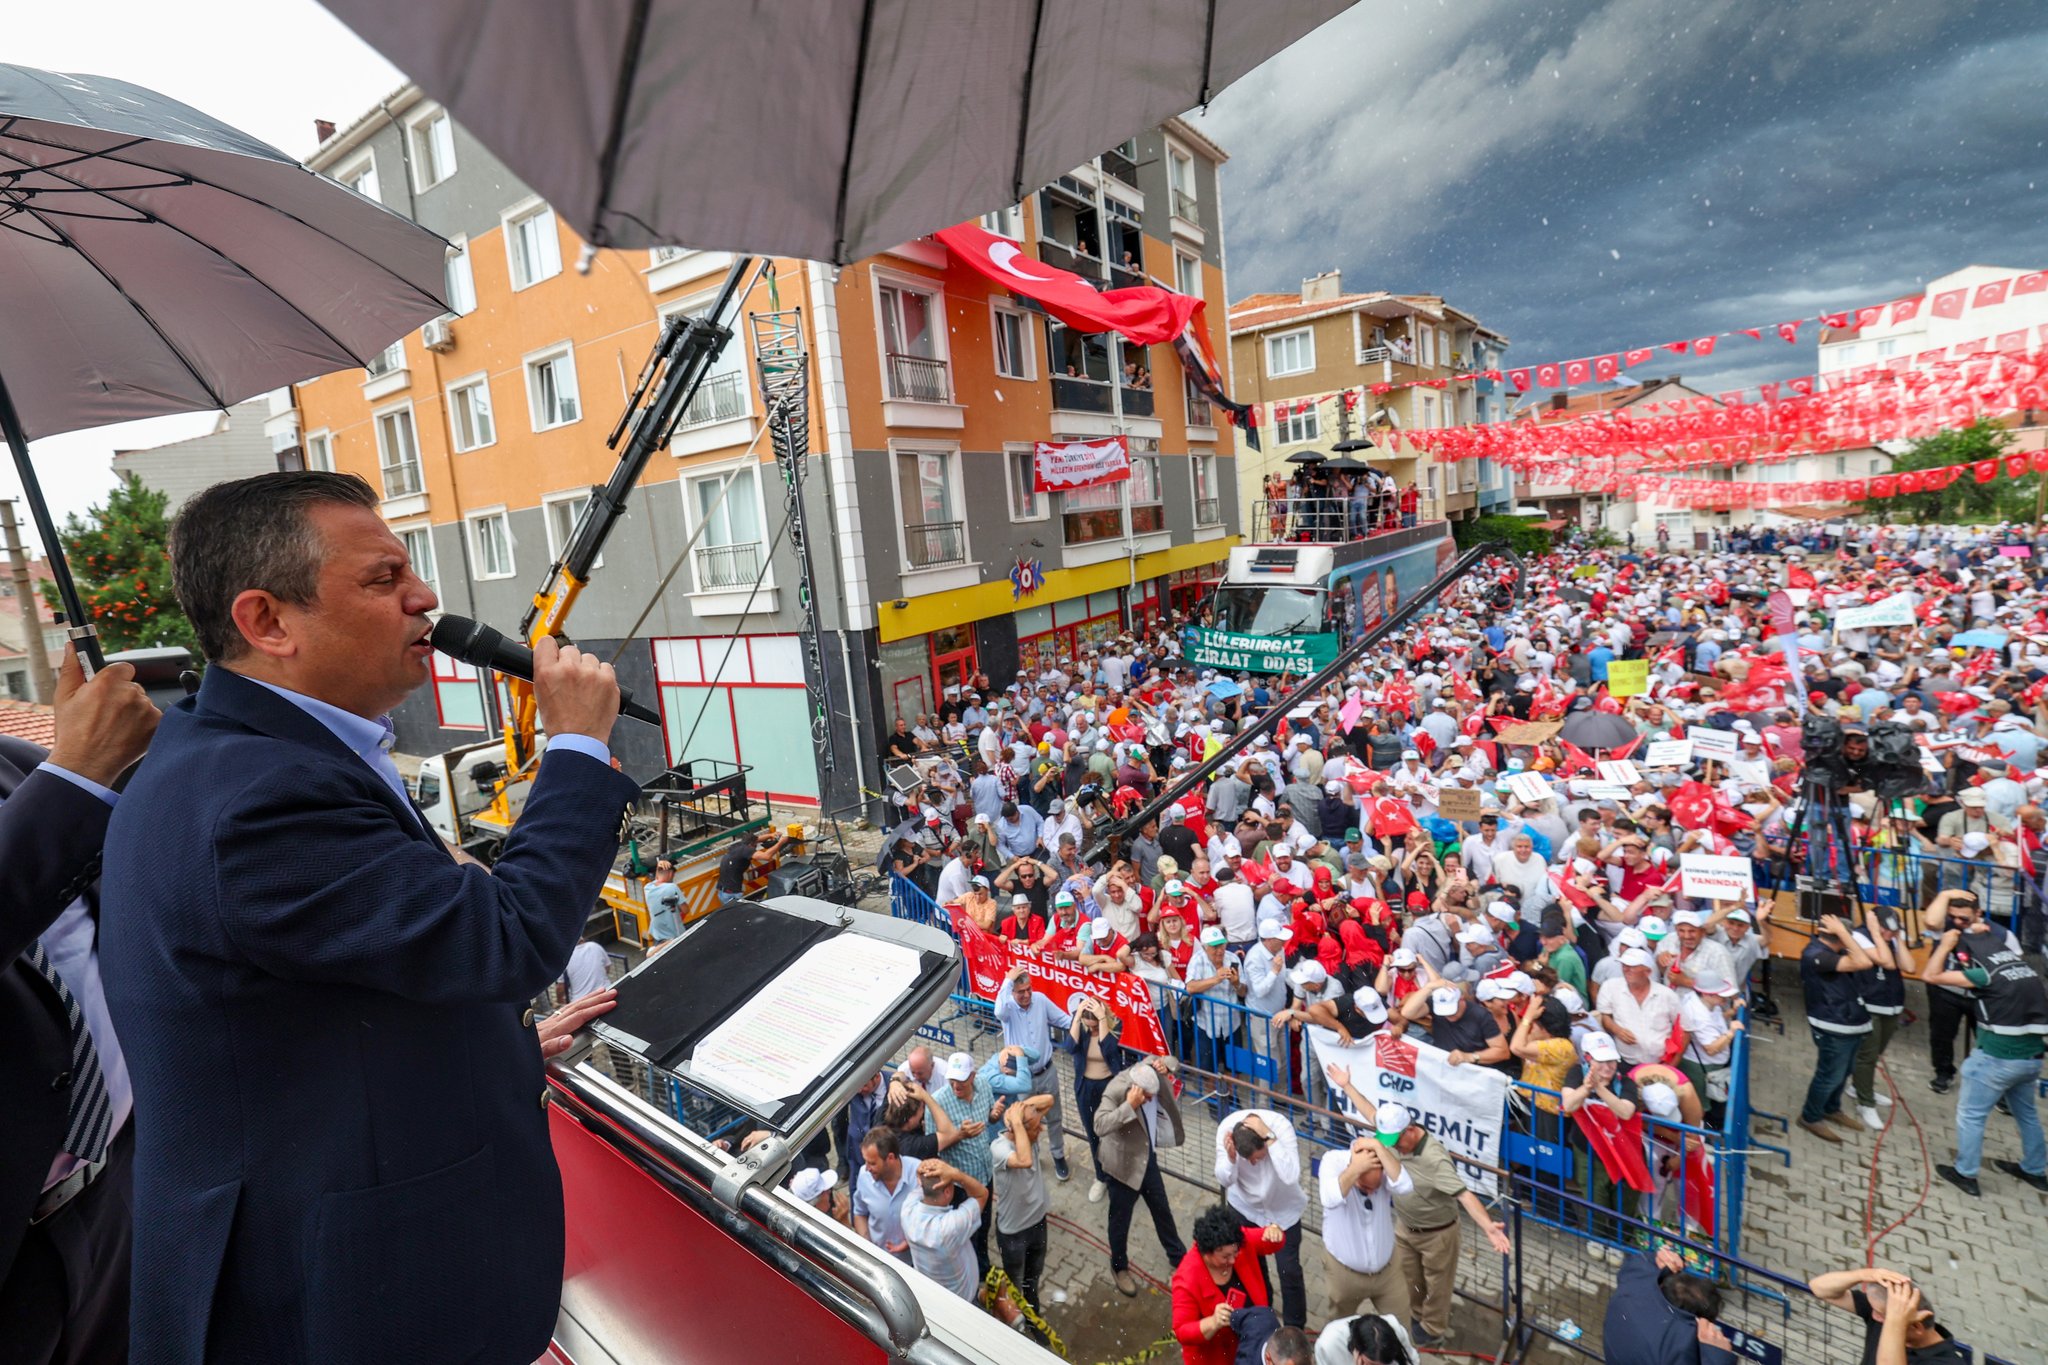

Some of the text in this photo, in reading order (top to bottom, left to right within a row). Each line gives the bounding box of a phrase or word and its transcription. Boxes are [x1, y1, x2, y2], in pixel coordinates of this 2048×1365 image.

[1204, 631, 1305, 654] LÜLEBURGAZ
[1194, 646, 1314, 672] ZİRAAT ODASI
[1691, 876, 1743, 887] YANINDA!
[918, 1026, 951, 1043] OLİS
[1379, 1071, 1415, 1093] CHP
[1378, 1098, 1490, 1151] REMİT
